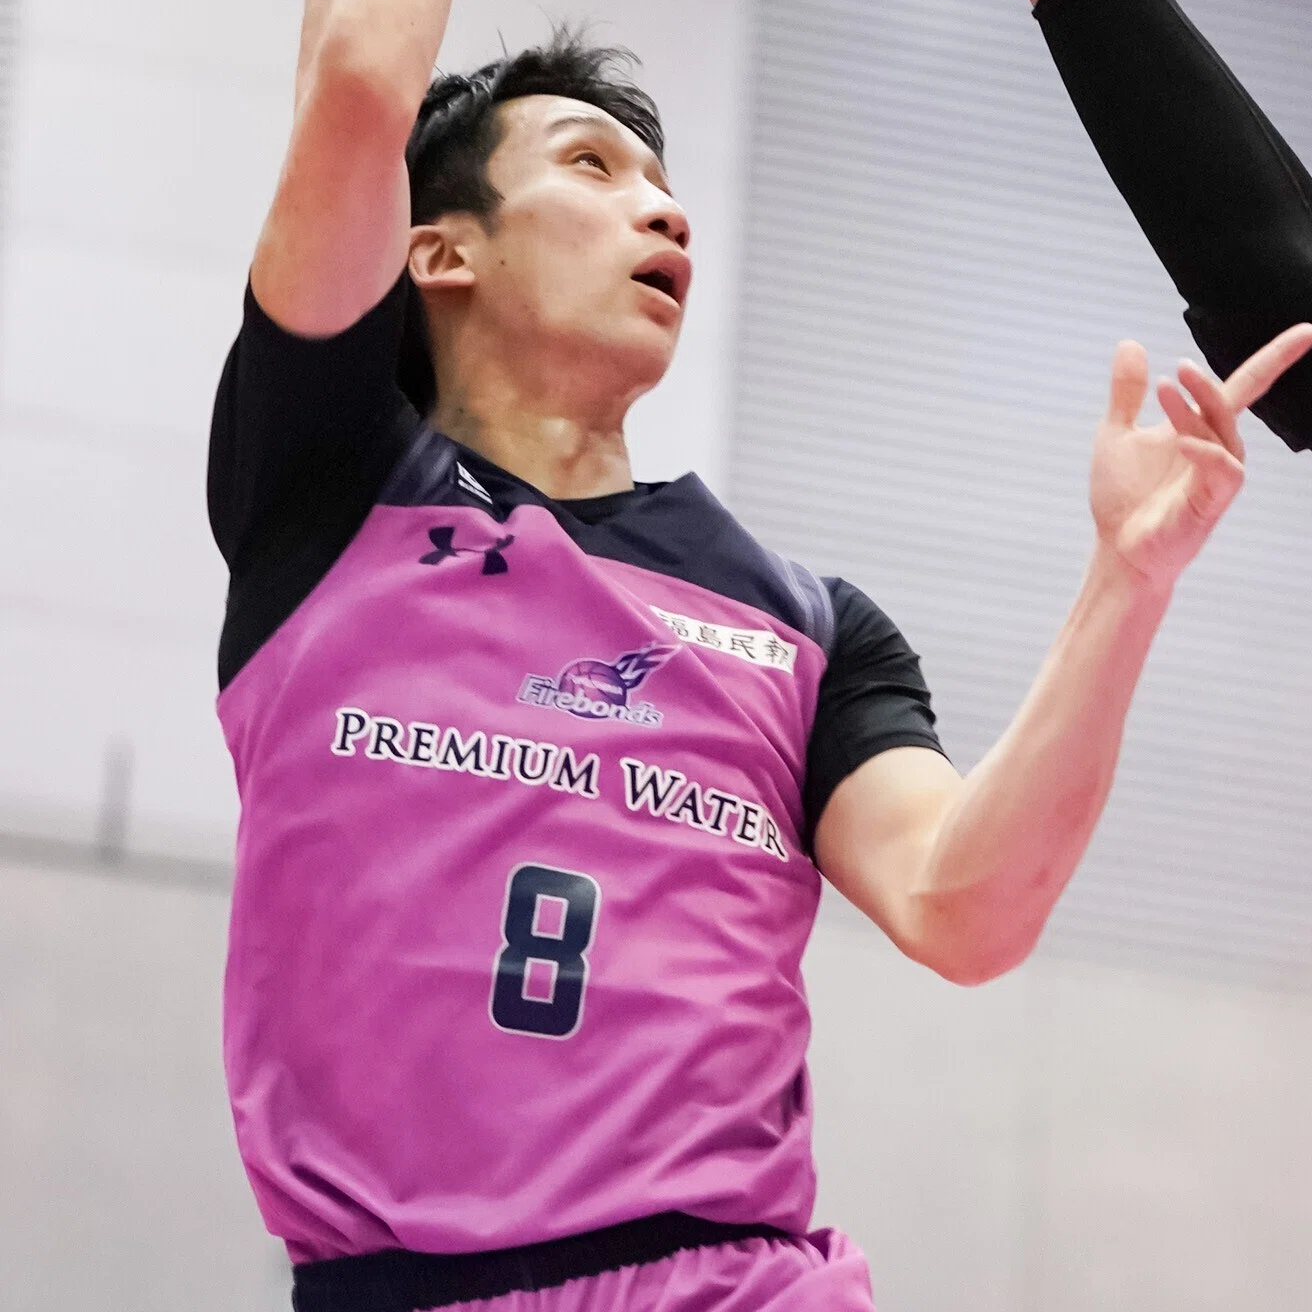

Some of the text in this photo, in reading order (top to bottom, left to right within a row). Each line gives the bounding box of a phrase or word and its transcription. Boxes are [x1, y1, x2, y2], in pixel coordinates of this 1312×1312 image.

[517, 673, 664, 728] Firebonds
[335, 709, 788, 860] PREMIUM WATER
[489, 863, 601, 1040] 8
